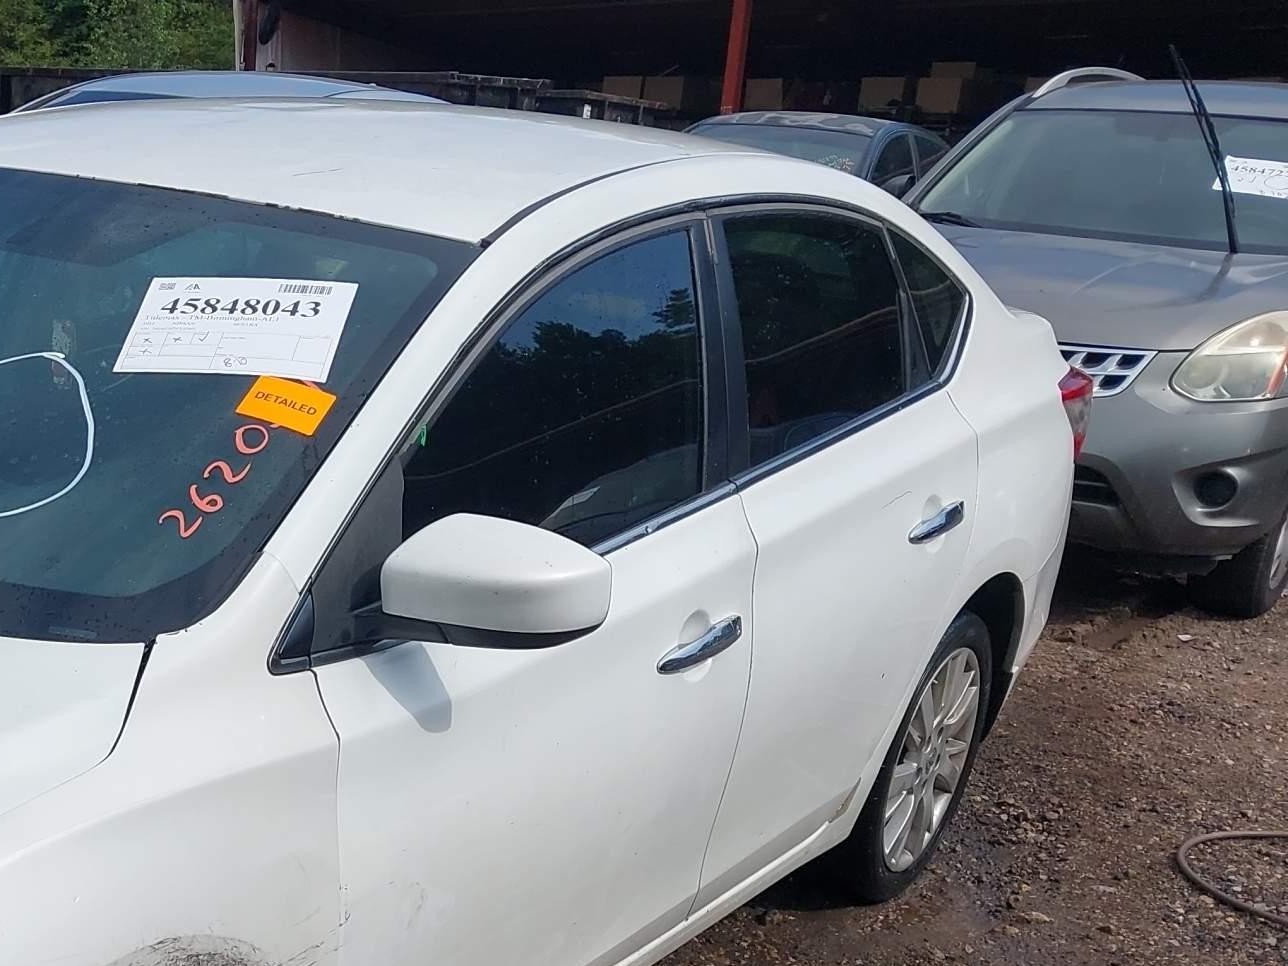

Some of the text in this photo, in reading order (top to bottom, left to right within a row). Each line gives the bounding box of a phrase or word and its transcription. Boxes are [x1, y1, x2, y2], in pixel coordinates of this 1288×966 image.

[1231, 165, 1288, 178] 458472
[160, 297, 321, 318] 45848043
[254, 391, 317, 416] DETAILED
[159, 423, 280, 538] 2620
